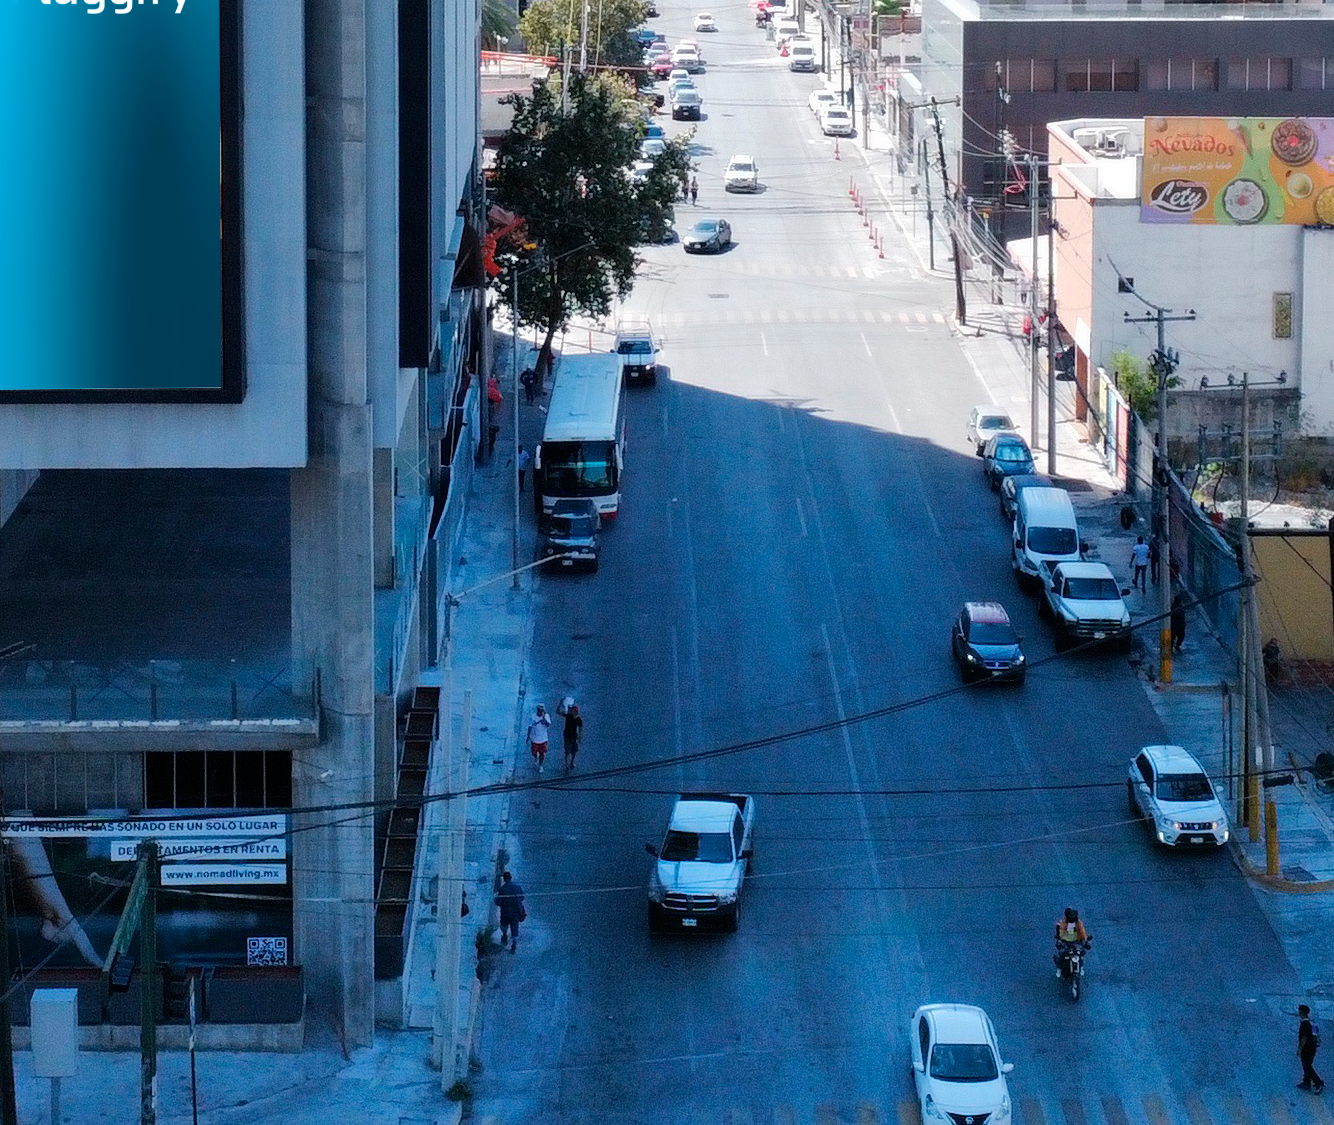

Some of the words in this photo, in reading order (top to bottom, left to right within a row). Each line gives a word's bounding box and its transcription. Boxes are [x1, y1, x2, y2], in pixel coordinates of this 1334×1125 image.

[1150, 135, 1234, 157] Nevados
[1151, 181, 1203, 213] Lety
[169, 822, 184, 831] EN
[187, 822, 203, 830] UN
[240, 821, 278, 830] LUGAR
[241, 844, 280, 854] RENTA
[166, 869, 279, 879] www.nomadliving.mx
